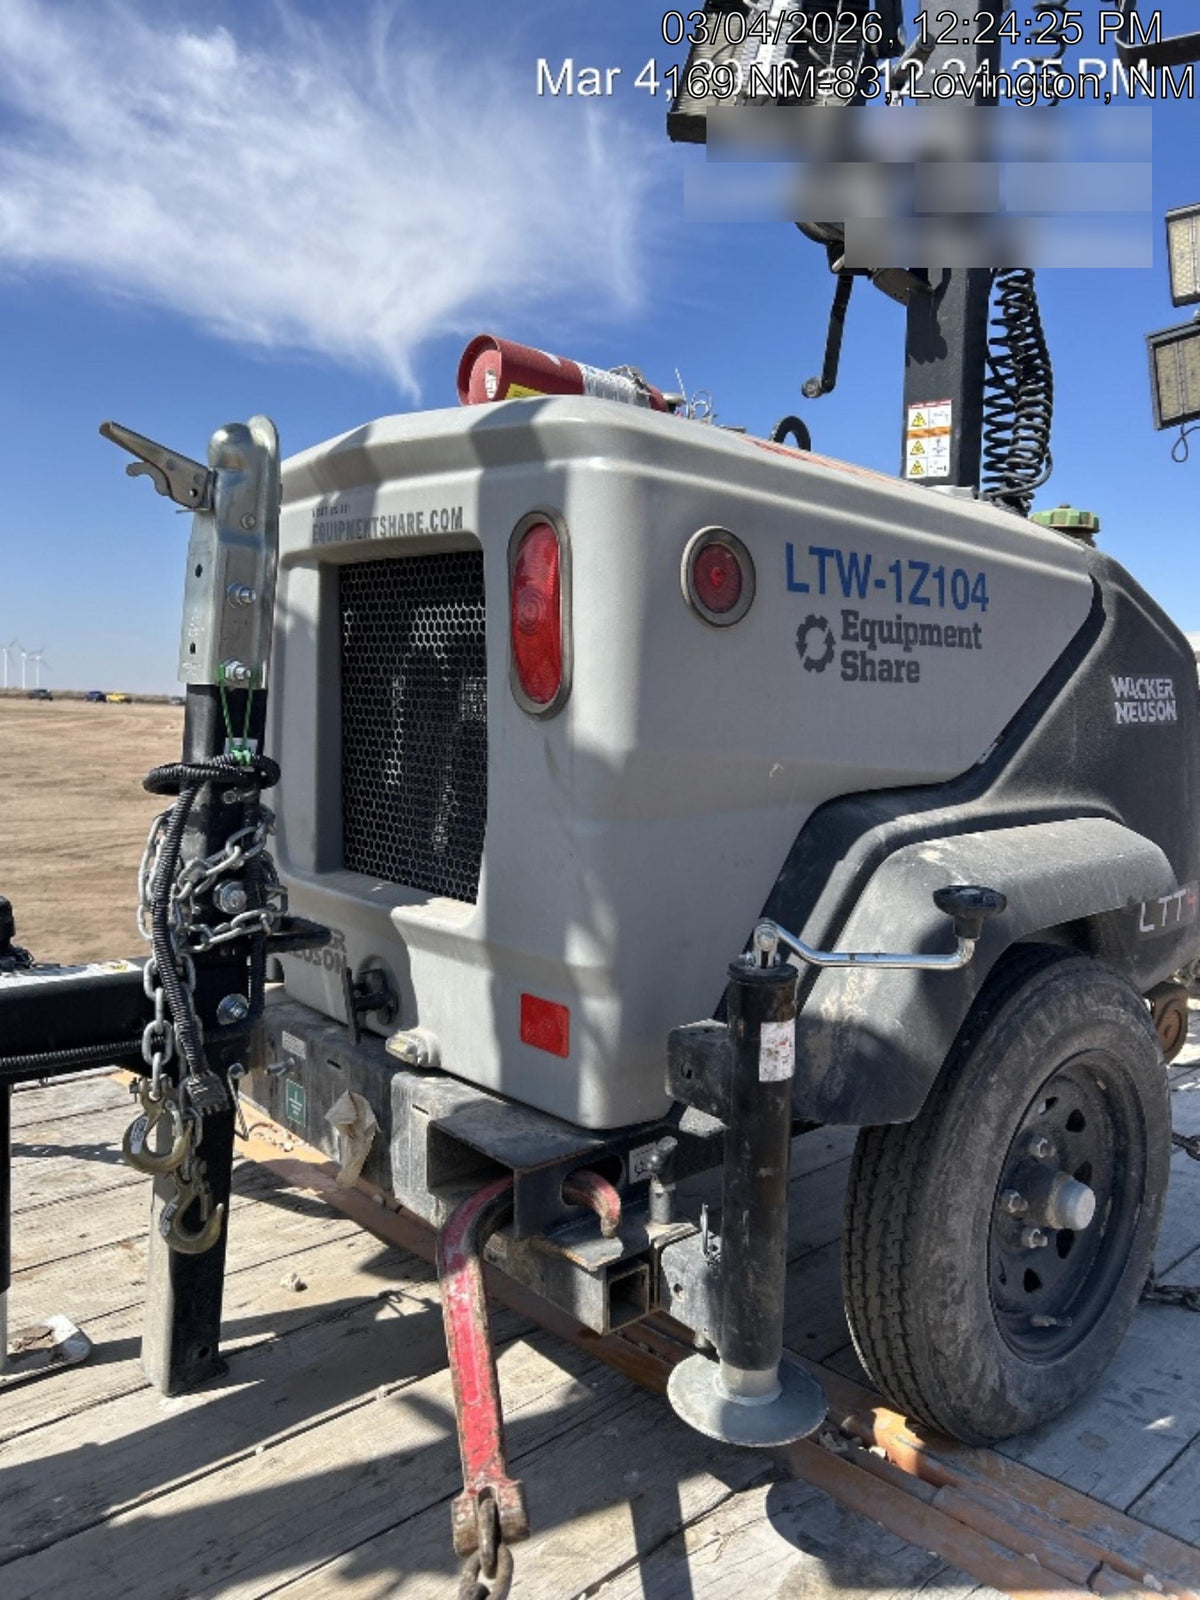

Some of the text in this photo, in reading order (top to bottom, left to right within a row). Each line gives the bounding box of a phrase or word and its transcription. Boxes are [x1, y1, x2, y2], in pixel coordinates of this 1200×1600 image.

[312, 506, 464, 545] EQUIPMENTSHARE.COM
[785, 542, 990, 612] LTW-1Z104
[840, 609, 983, 652] Equipment
[840, 649, 921, 683] Share
[1111, 676, 1176, 700] WACKER
[1114, 700, 1178, 725] NEUSON
